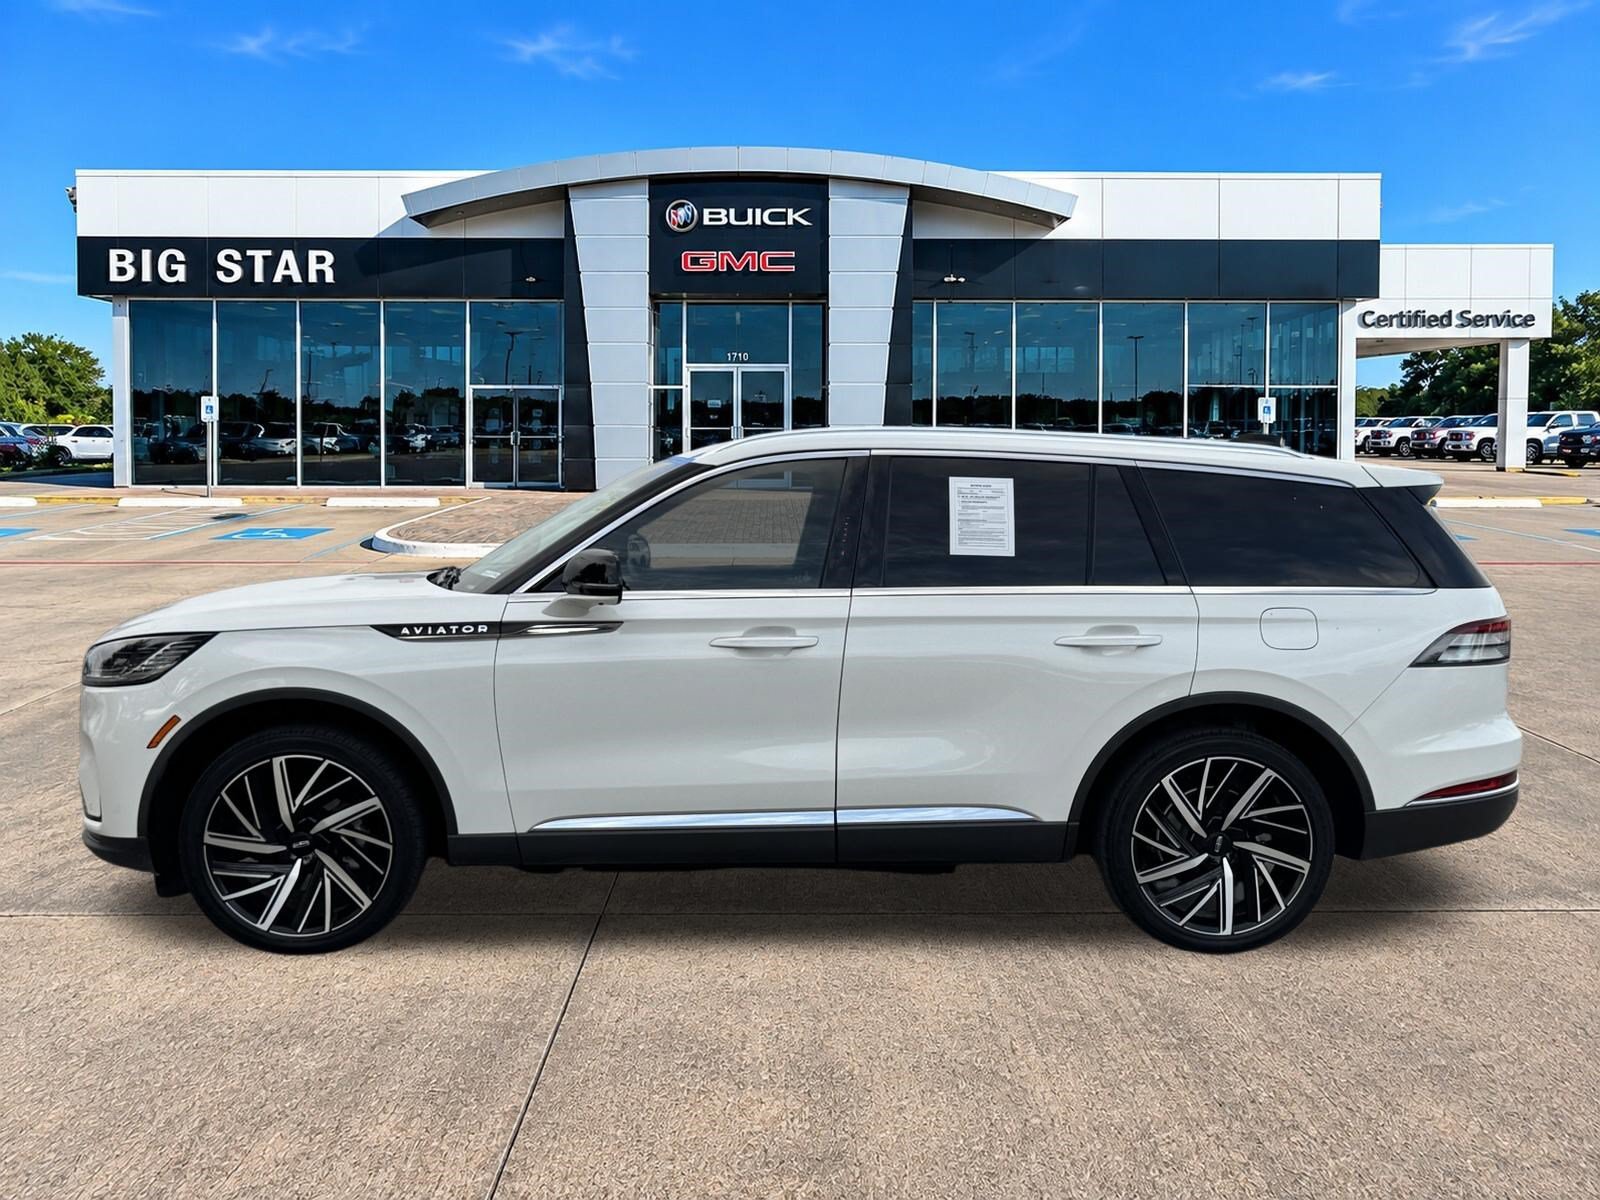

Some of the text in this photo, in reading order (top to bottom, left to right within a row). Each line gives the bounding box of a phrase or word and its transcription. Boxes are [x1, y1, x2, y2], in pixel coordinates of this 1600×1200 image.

[702, 207, 813, 226] BUICK
[108, 248, 336, 284] BIG STAR
[681, 250, 796, 272] GMC
[1360, 309, 1536, 328] Certified Service
[726, 352, 749, 362] 1710
[400, 624, 489, 636] AVIATOR
